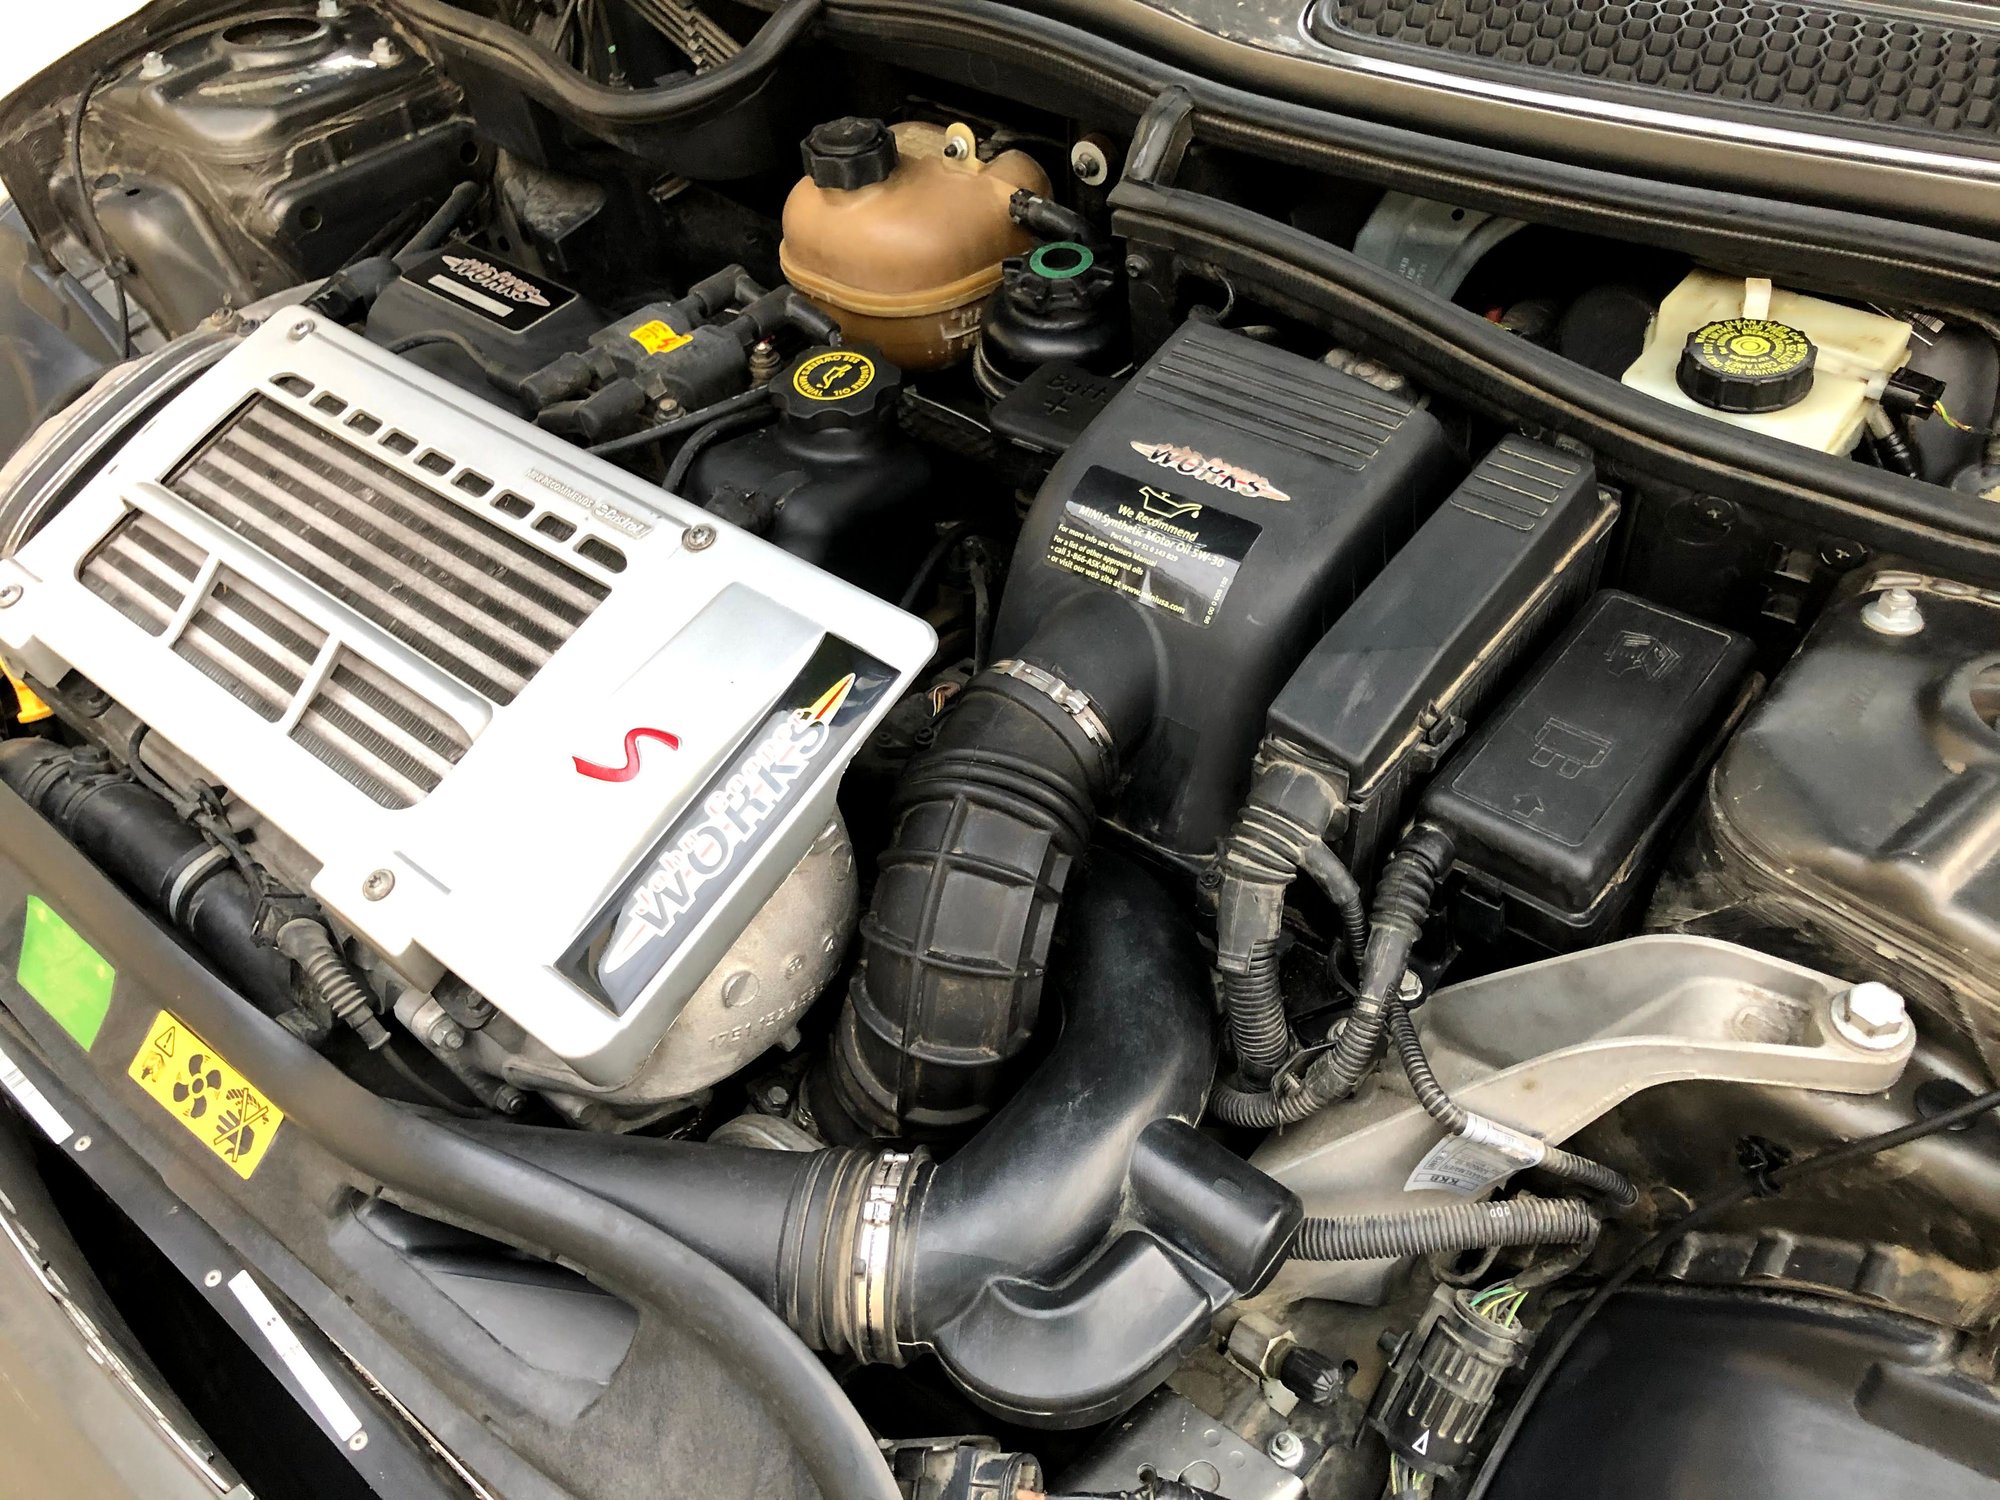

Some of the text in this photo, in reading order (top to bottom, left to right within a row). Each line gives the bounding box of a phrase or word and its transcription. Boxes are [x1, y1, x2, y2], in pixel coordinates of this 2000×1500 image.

[1724, 320, 1757, 330] CLEAN
[1789, 332, 1805, 343] CAP
[1705, 355, 1723, 368] ONLY
[1721, 367, 1742, 375] USE
[1724, 360, 1778, 370] CONTAINER
[1746, 363, 1793, 376] REMOVING
[799, 375, 824, 397] MANUAL
[851, 365, 870, 389] ENGINE
[833, 387, 851, 397] OIL
[542, 476, 594, 508] RECOMMENDS
[606, 507, 645, 534] Castrol
[1118, 504, 1200, 542] We Recommend
[1058, 523, 1158, 568] For more info see Owners Manual
[1079, 505, 1225, 568] MINI Synthetic Motor Oil 5W-30
[1110, 531, 1122, 541] Part
[1122, 536, 1132, 545] No.
[1053, 534, 1064, 544] For
[1068, 540, 1079, 550] list
[1078, 545, 1087, 553] of
[1085, 549, 1103, 560] other
[1102, 555, 1132, 571] approved
[1132, 564, 1145, 576] oils
[1054, 546, 1119, 576] call 1-866-ASK-MINI
[1059, 558, 1074, 569] visit
[1073, 564, 1085, 574] our
[1085, 568, 1100, 580] web
[1099, 573, 1113, 586] site
[1112, 578, 1122, 588] at
[1121, 583, 1187, 615] www.miniusa.com
[571, 727, 680, 783] S
[634, 719, 827, 933] WORKS
